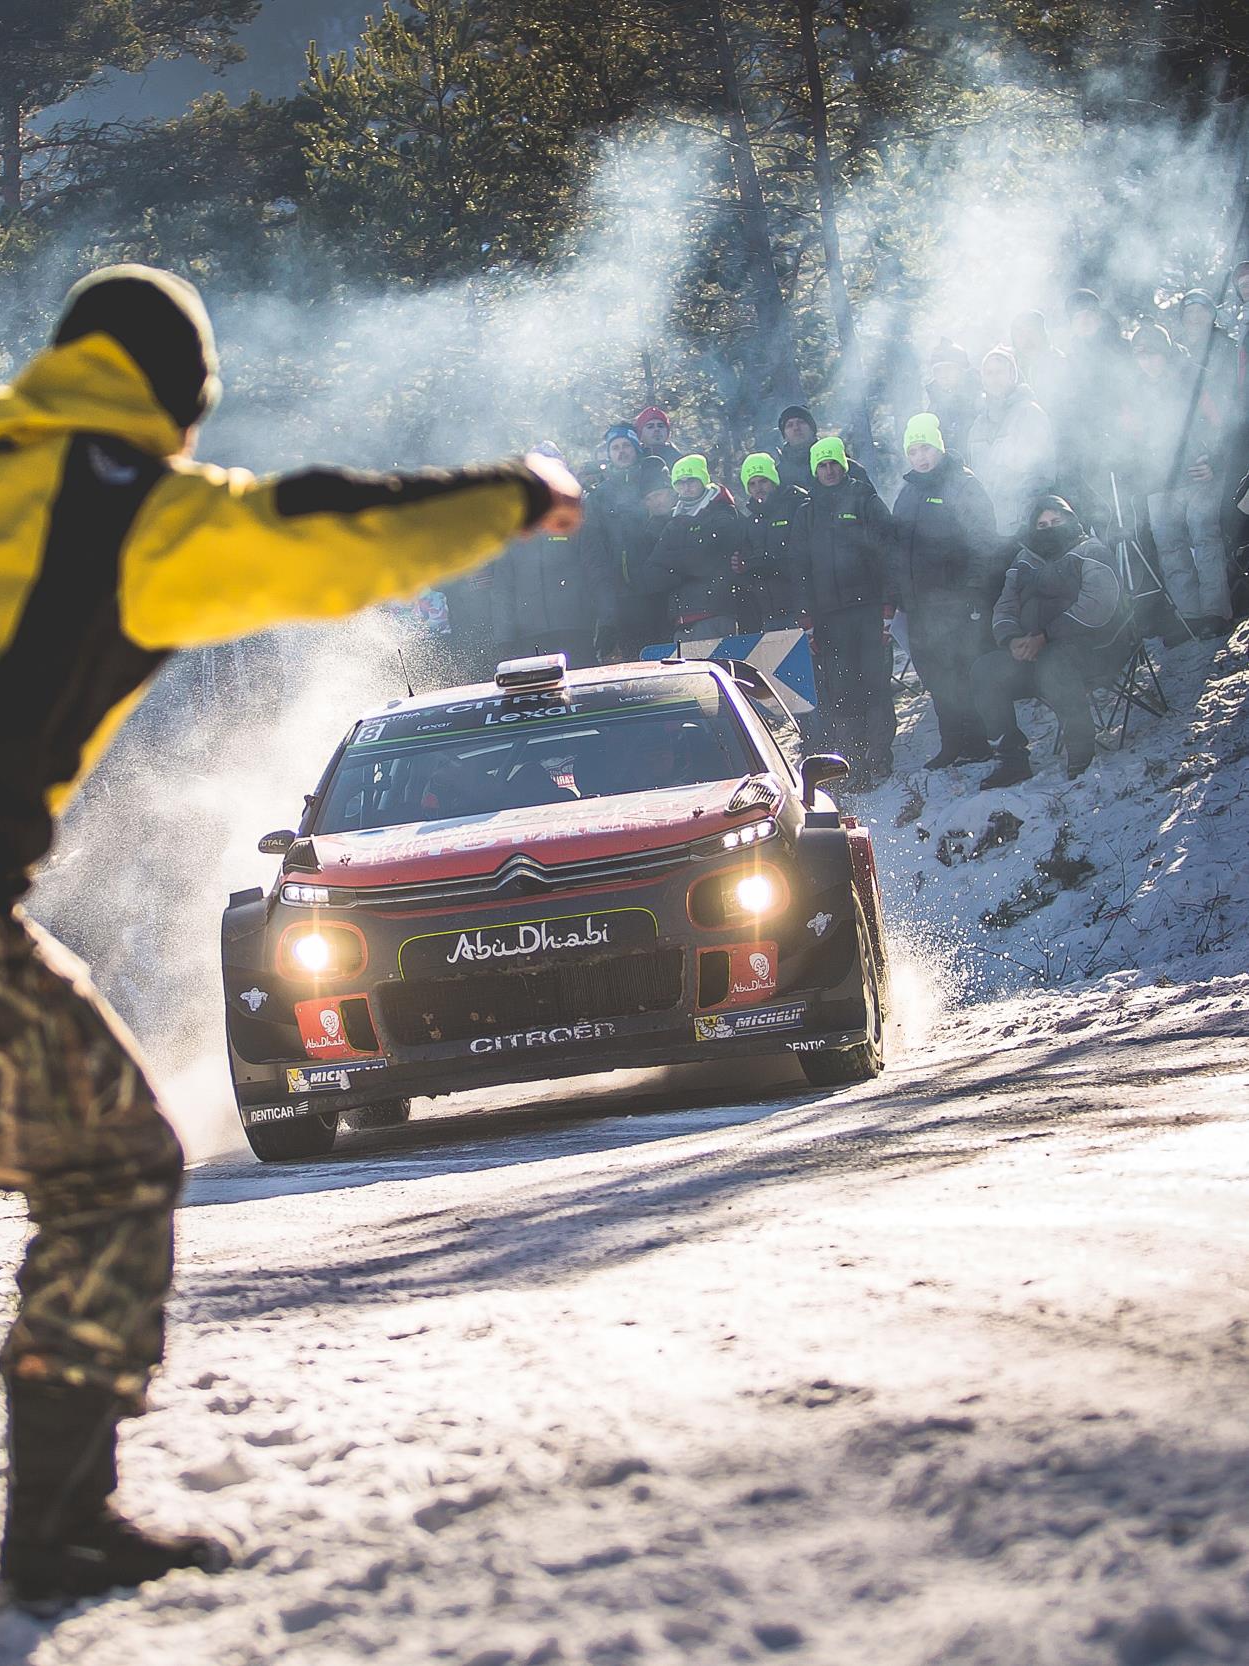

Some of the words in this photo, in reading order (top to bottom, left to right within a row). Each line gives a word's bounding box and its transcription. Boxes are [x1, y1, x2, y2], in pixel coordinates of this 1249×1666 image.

[484, 702, 583, 725] Lexar
[359, 725, 379, 743] 8
[416, 721, 453, 731] Lexar
[260, 838, 285, 847] OTAL
[250, 1106, 295, 1123] IDENTICAR
